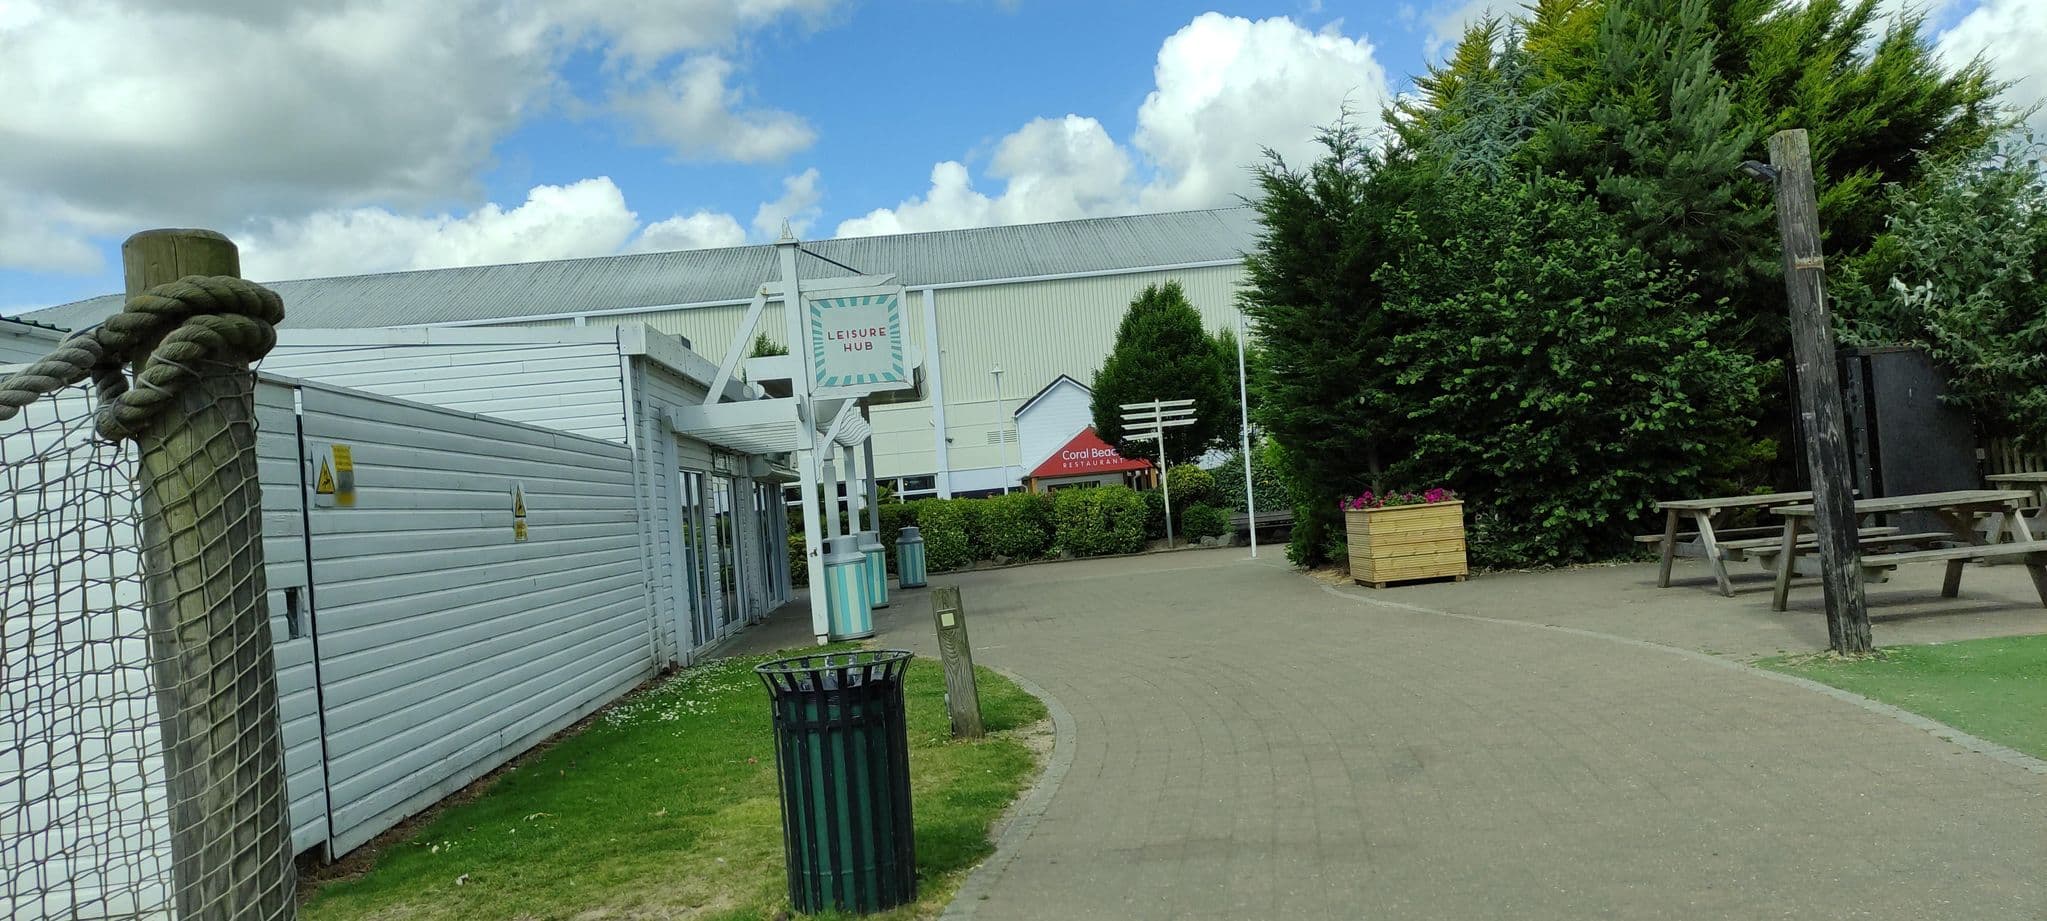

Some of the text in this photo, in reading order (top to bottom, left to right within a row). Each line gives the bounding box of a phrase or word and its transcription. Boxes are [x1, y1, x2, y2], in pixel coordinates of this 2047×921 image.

[827, 327, 887, 341] LEISURE
[843, 341, 873, 352] HUB
[1062, 448, 1119, 460] Coral Beac
[1062, 457, 1124, 468] RESTAURANT
